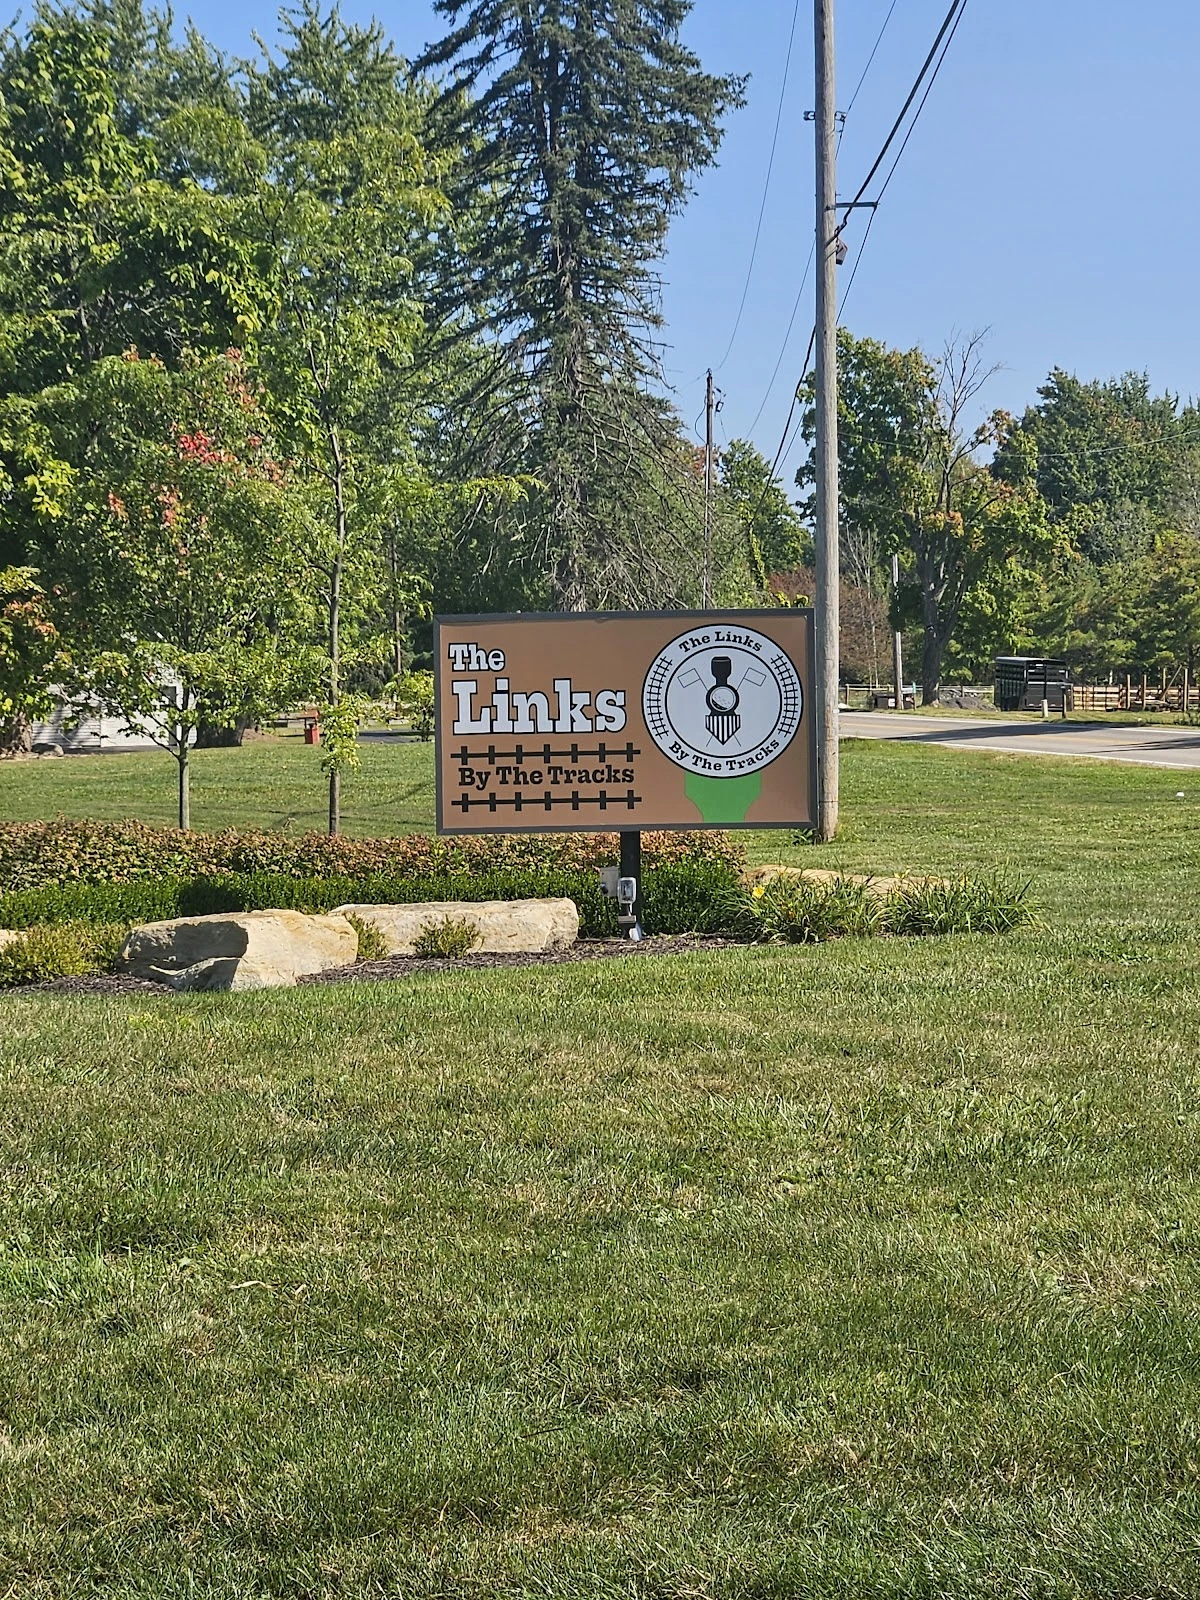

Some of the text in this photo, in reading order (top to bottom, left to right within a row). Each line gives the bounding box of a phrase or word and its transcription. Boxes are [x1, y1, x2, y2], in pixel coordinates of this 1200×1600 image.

[449, 642, 506, 672] The
[678, 631, 763, 653] The Links
[452, 677, 627, 735] Links
[669, 739, 780, 771] By The Tracks
[458, 765, 635, 791] By The Tracks
